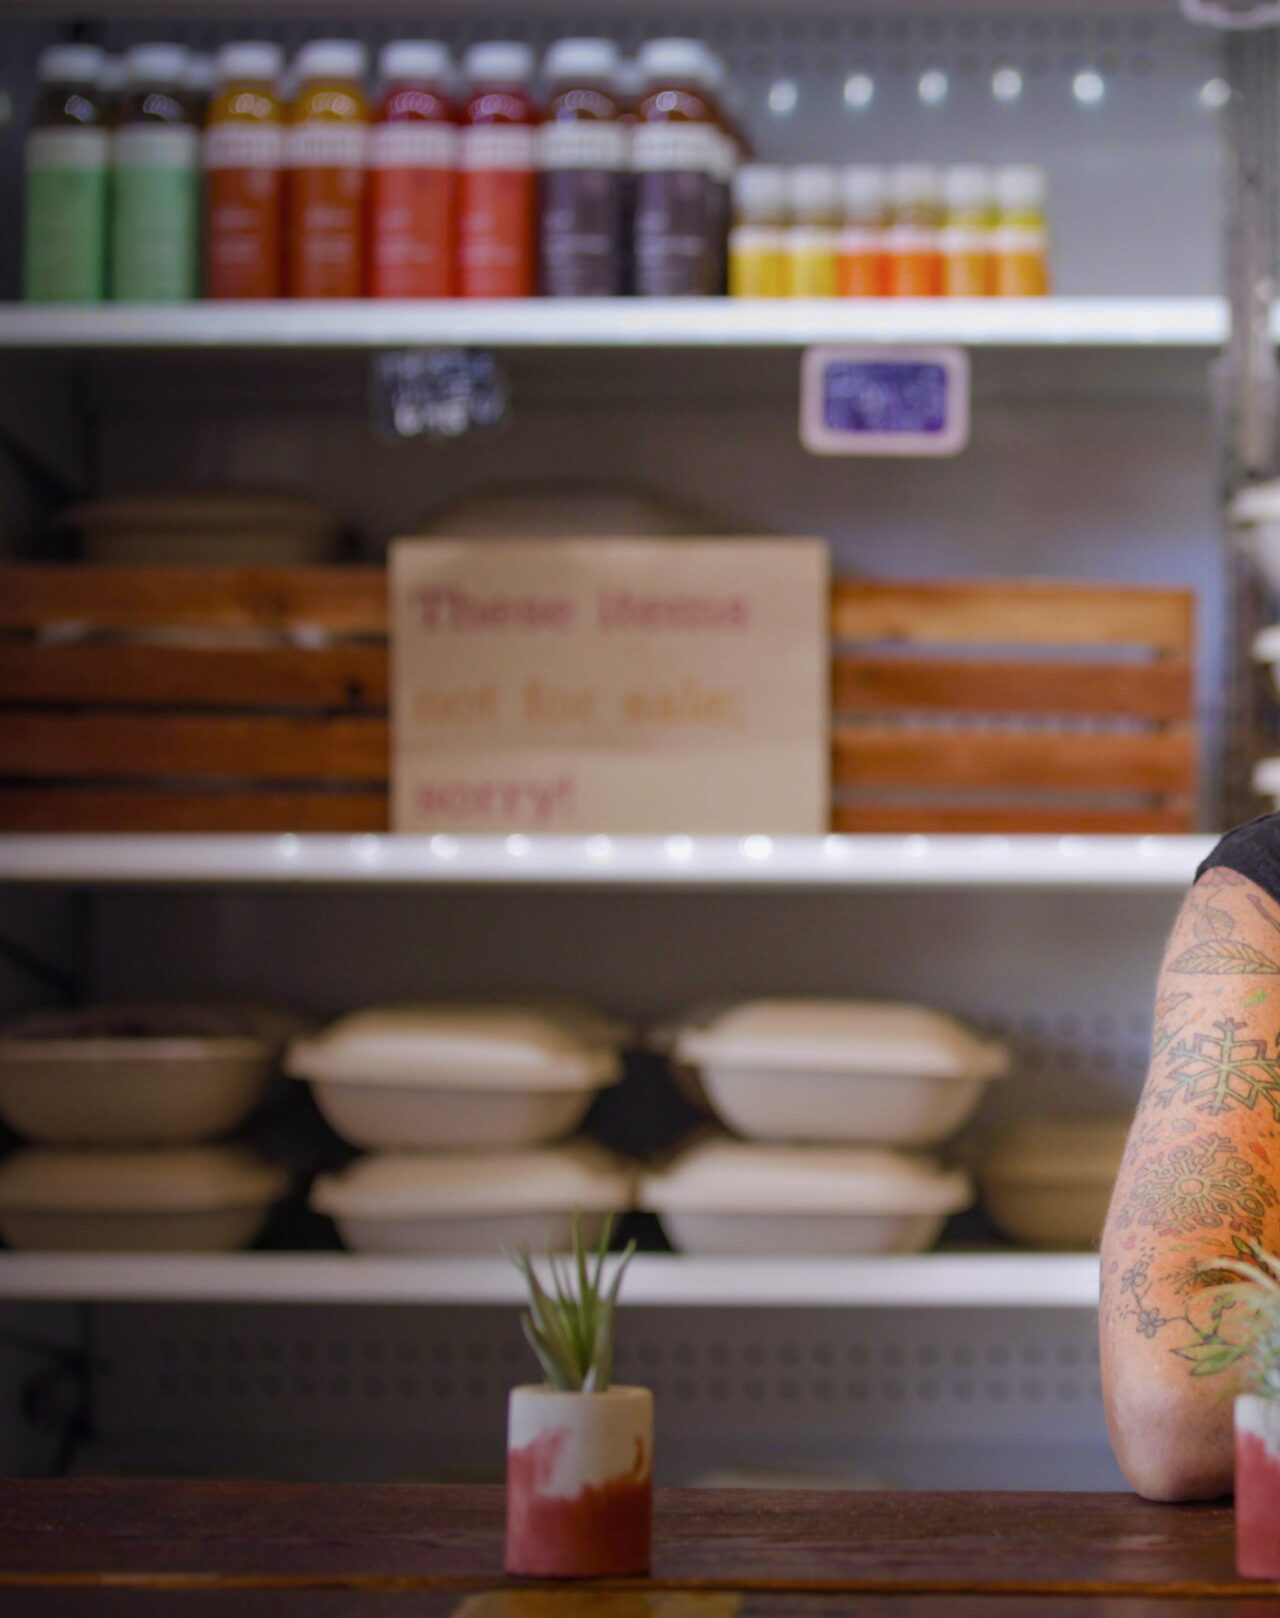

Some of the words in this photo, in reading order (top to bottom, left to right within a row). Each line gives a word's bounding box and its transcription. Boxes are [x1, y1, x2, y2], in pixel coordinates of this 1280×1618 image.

[410, 583, 574, 631] These
[599, 588, 748, 631] items
[414, 684, 497, 723] not
[522, 679, 593, 723] for
[415, 778, 576, 822] sorry!
